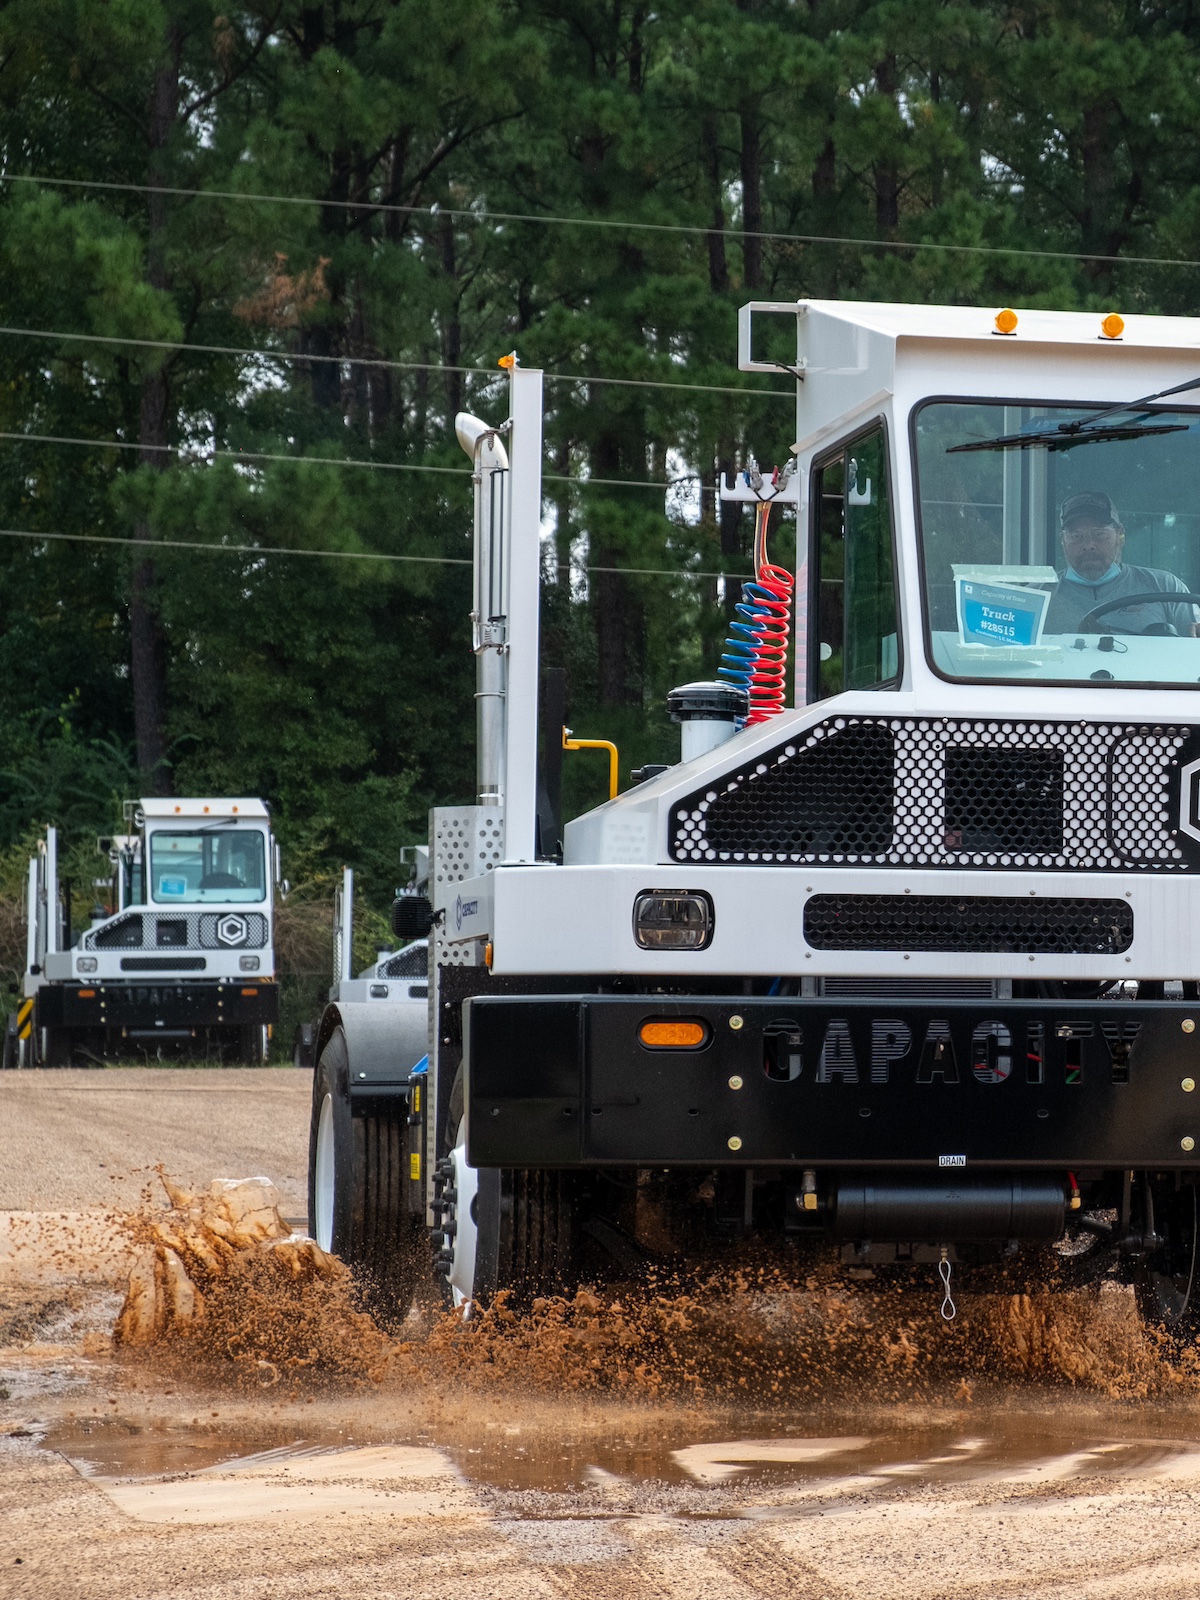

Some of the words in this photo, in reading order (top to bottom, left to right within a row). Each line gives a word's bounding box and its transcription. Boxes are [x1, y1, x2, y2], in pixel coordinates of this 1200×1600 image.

[982, 606, 1015, 621] Truck
[980, 621, 1015, 636] #28515
[762, 1018, 1142, 1084] CAPACITY
[940, 1156, 964, 1166] DRAIN
